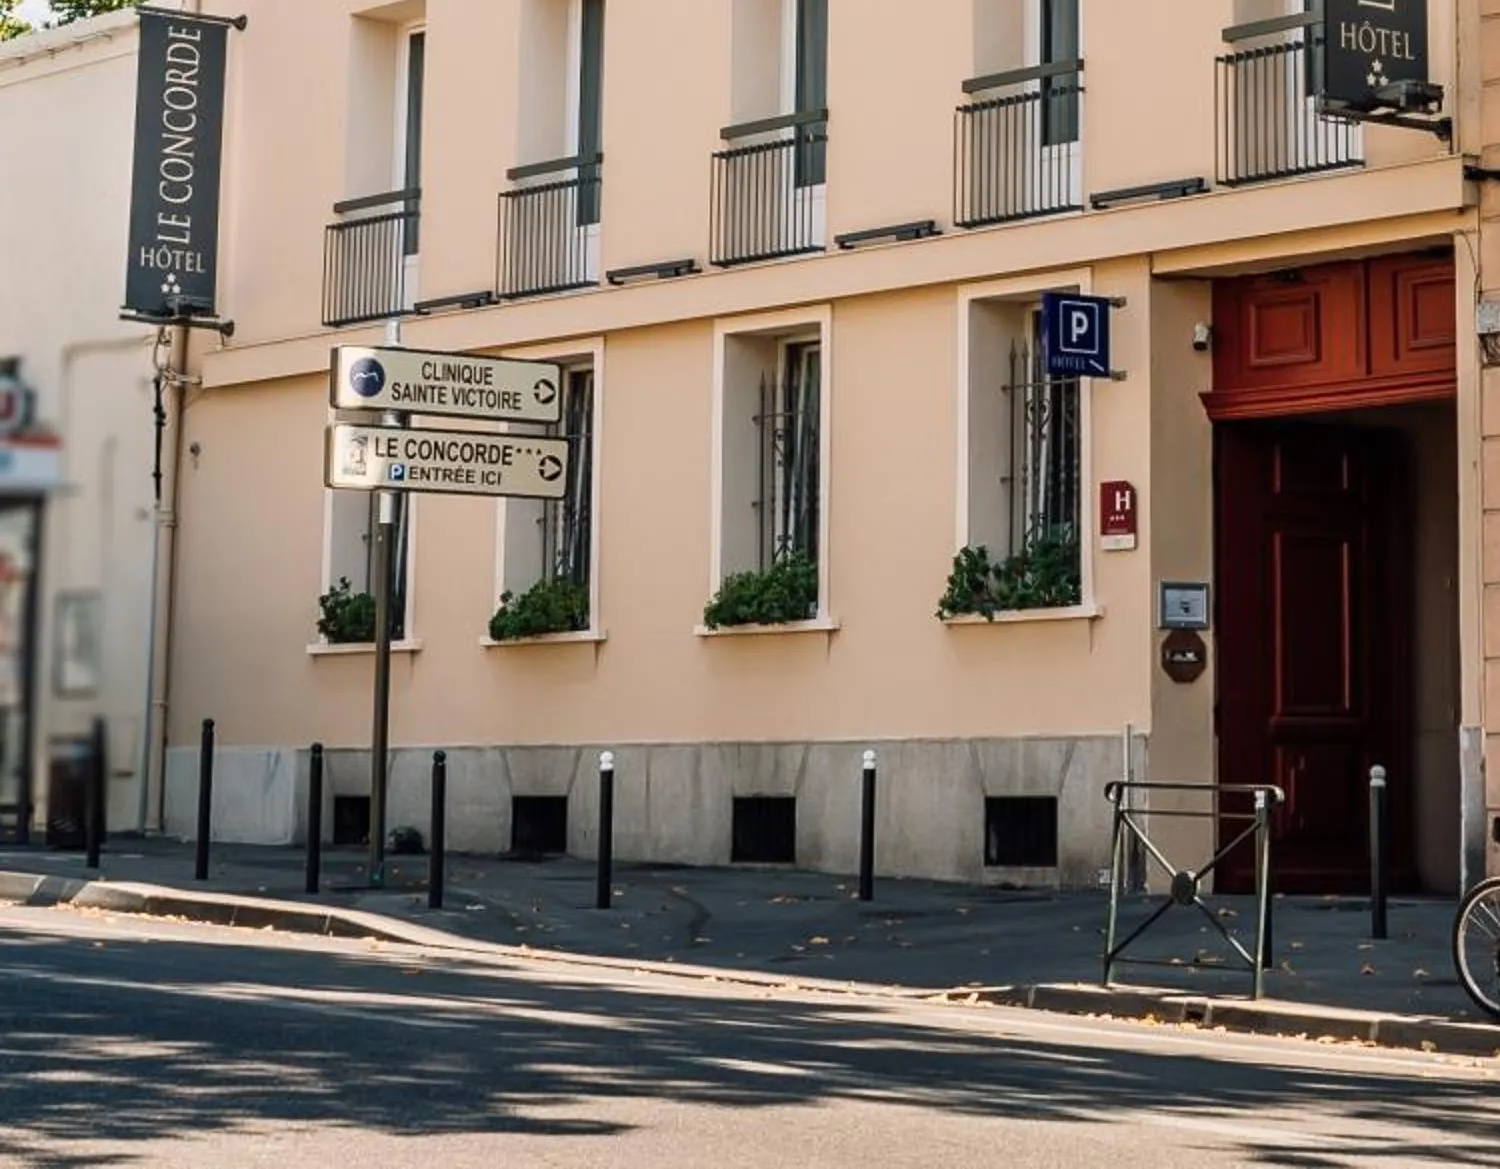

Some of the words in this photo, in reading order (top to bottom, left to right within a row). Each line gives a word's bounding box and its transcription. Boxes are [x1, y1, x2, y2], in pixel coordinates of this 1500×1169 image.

[1340, 20, 1415, 60] HÔTEL
[159, 25, 201, 204] CONCORDE
[157, 212, 191, 245] LE
[140, 244, 206, 273] HÔTEL
[1071, 311, 1088, 343] P
[421, 361, 493, 385] CLINIQUE
[391, 382, 447, 405] SAINTE
[452, 388, 522, 410] VICTOIRE
[375, 436, 399, 458] LE
[404, 439, 513, 465] CONCORDE
[409, 465, 475, 484] ENTRÉE
[481, 471, 501, 486] ICI
[1114, 490, 1131, 511] H
